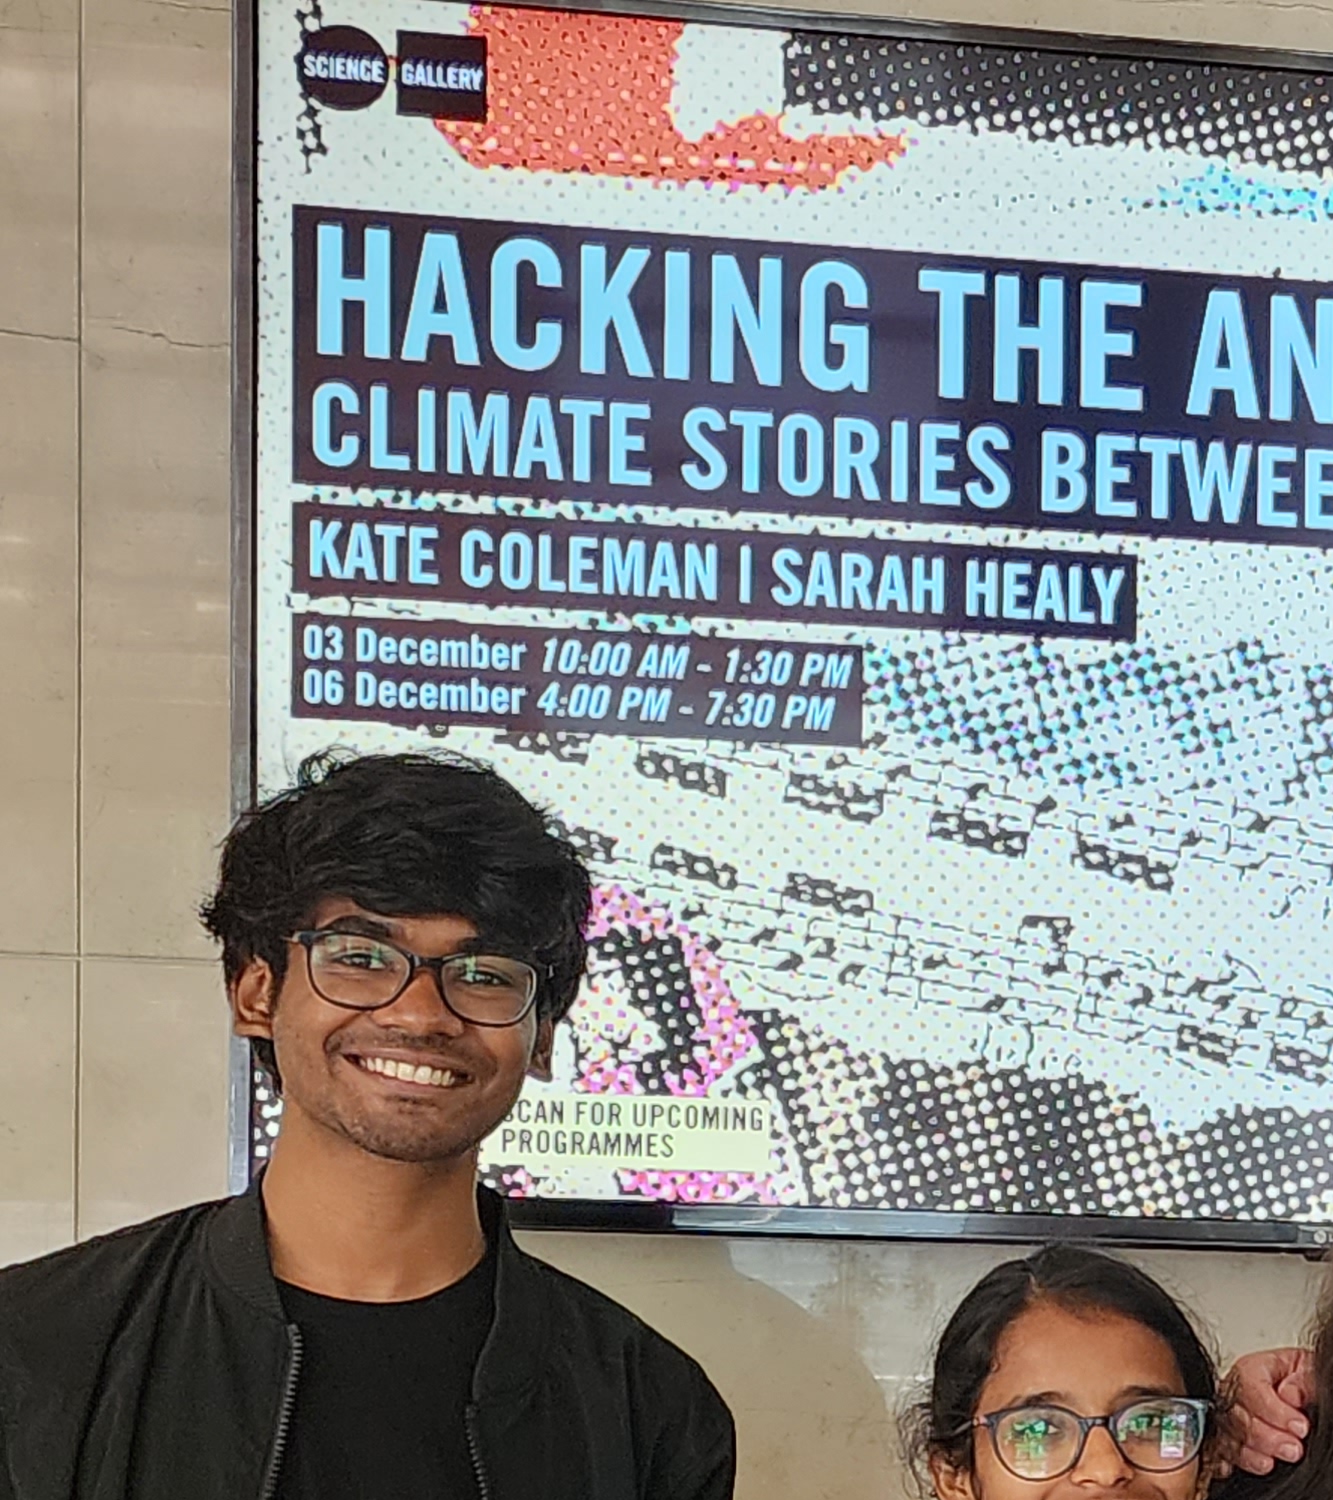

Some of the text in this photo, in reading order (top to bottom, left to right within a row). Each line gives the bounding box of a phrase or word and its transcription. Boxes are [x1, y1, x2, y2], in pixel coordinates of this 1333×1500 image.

[303, 54, 483, 91] SCIENCE GALLERY
[316, 222, 869, 393] HACKING
[919, 269, 1142, 411] THE
[312, 382, 651, 486] CLIMATE
[681, 406, 1011, 510] STORIES
[309, 519, 439, 585] KATE
[460, 529, 717, 601] COLEMAN
[771, 548, 945, 614] SARAH
[965, 559, 1125, 624] HEALY
[303, 624, 343, 662] 03
[356, 627, 527, 672] December
[542, 638, 632, 677] 10:00
[637, 643, 690, 680] AM
[724, 648, 793, 686] 1:30
[800, 651, 853, 690] PM
[303, 671, 344, 707] 06
[356, 671, 527, 716] December
[537, 681, 610, 719] 4:00
[617, 685, 672, 723] PM
[704, 689, 775, 729] 7:30
[782, 692, 836, 732] PM
[502, 1129, 675, 1158] PROGRAMMES
[575, 1101, 622, 1127] FOR
[633, 1104, 764, 1131] UPCOMING
